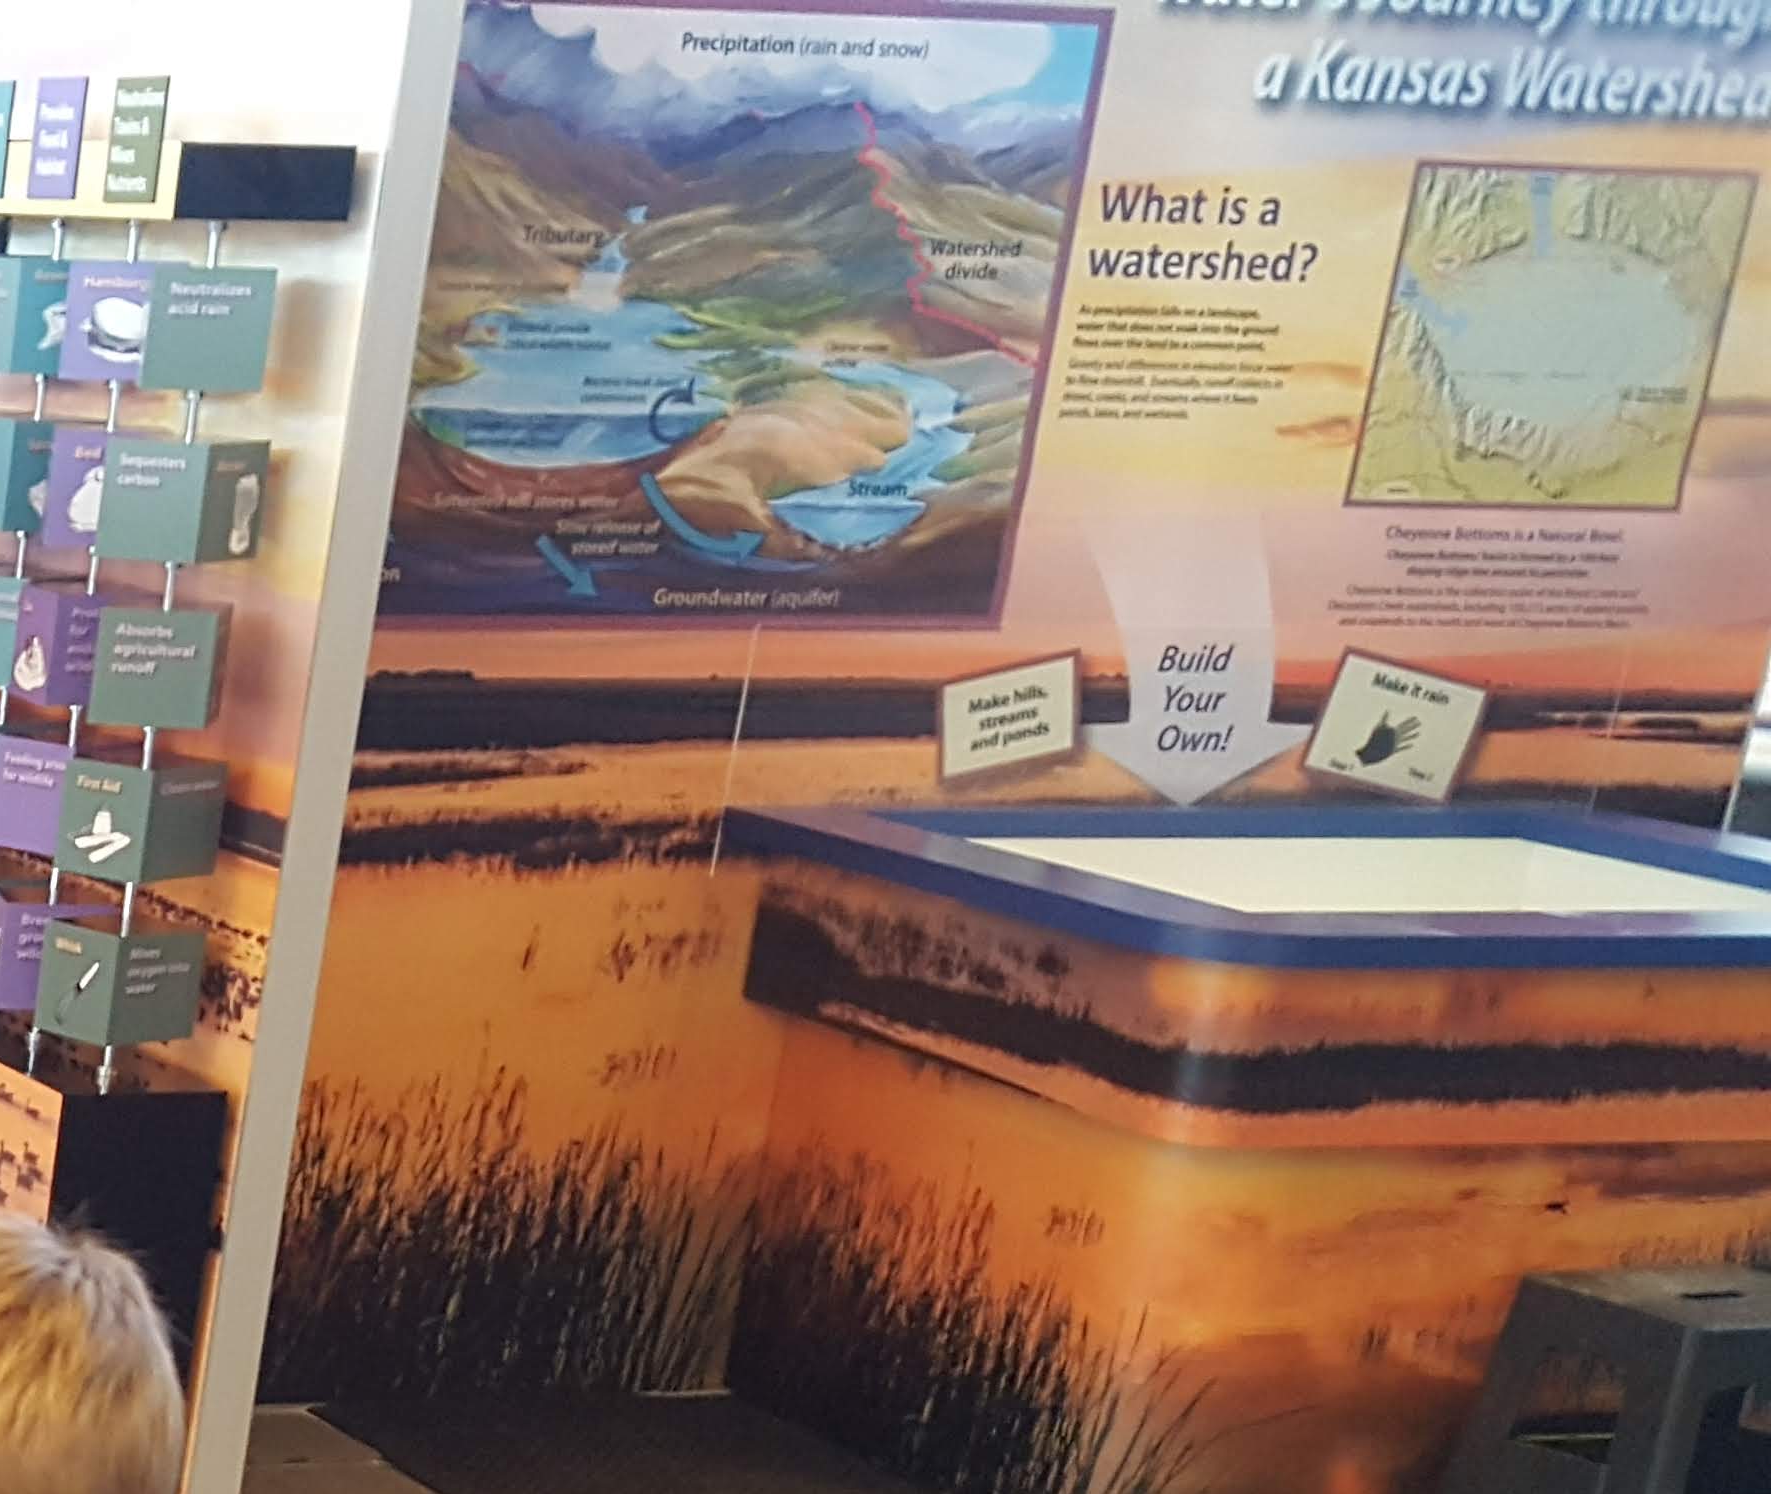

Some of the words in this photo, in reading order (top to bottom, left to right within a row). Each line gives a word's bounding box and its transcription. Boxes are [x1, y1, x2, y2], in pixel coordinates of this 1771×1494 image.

[681, 31, 795, 56] Precipitation
[799, 36, 837, 57] (rain
[841, 38, 876, 57] and
[878, 40, 931, 60] snow)
[1253, 52, 1290, 101] a
[1296, 37, 1491, 106] Kansas
[1100, 183, 1208, 225] What
[1218, 186, 1249, 225] is
[1258, 197, 1282, 226] a
[522, 223, 607, 249] Tributary
[930, 238, 1024, 258] Watershed
[1088, 240, 1319, 283] watershed?
[945, 263, 999, 282] divide
[170, 281, 253, 299] Neutralizes
[168, 300, 199, 317] acid
[120, 453, 187, 472] Sequesters
[846, 479, 909, 498] Stream
[1386, 525, 1451, 543] Cheyenne
[653, 588, 769, 608] Groundwater
[770, 588, 841, 609] (aquifer)
[116, 623, 175, 641] Absorbs
[114, 643, 196, 661] agricultural
[1157, 644, 1235, 673] Build
[111, 660, 156, 678] runoff
[1163, 685, 1226, 713] Your
[1371, 672, 1409, 694] Make
[1422, 688, 1450, 705] rain
[967, 693, 1010, 714] Make
[979, 706, 1039, 731] streams
[969, 732, 1000, 751] and
[1001, 722, 1051, 748] ponds
[1157, 724, 1235, 753] Own!
